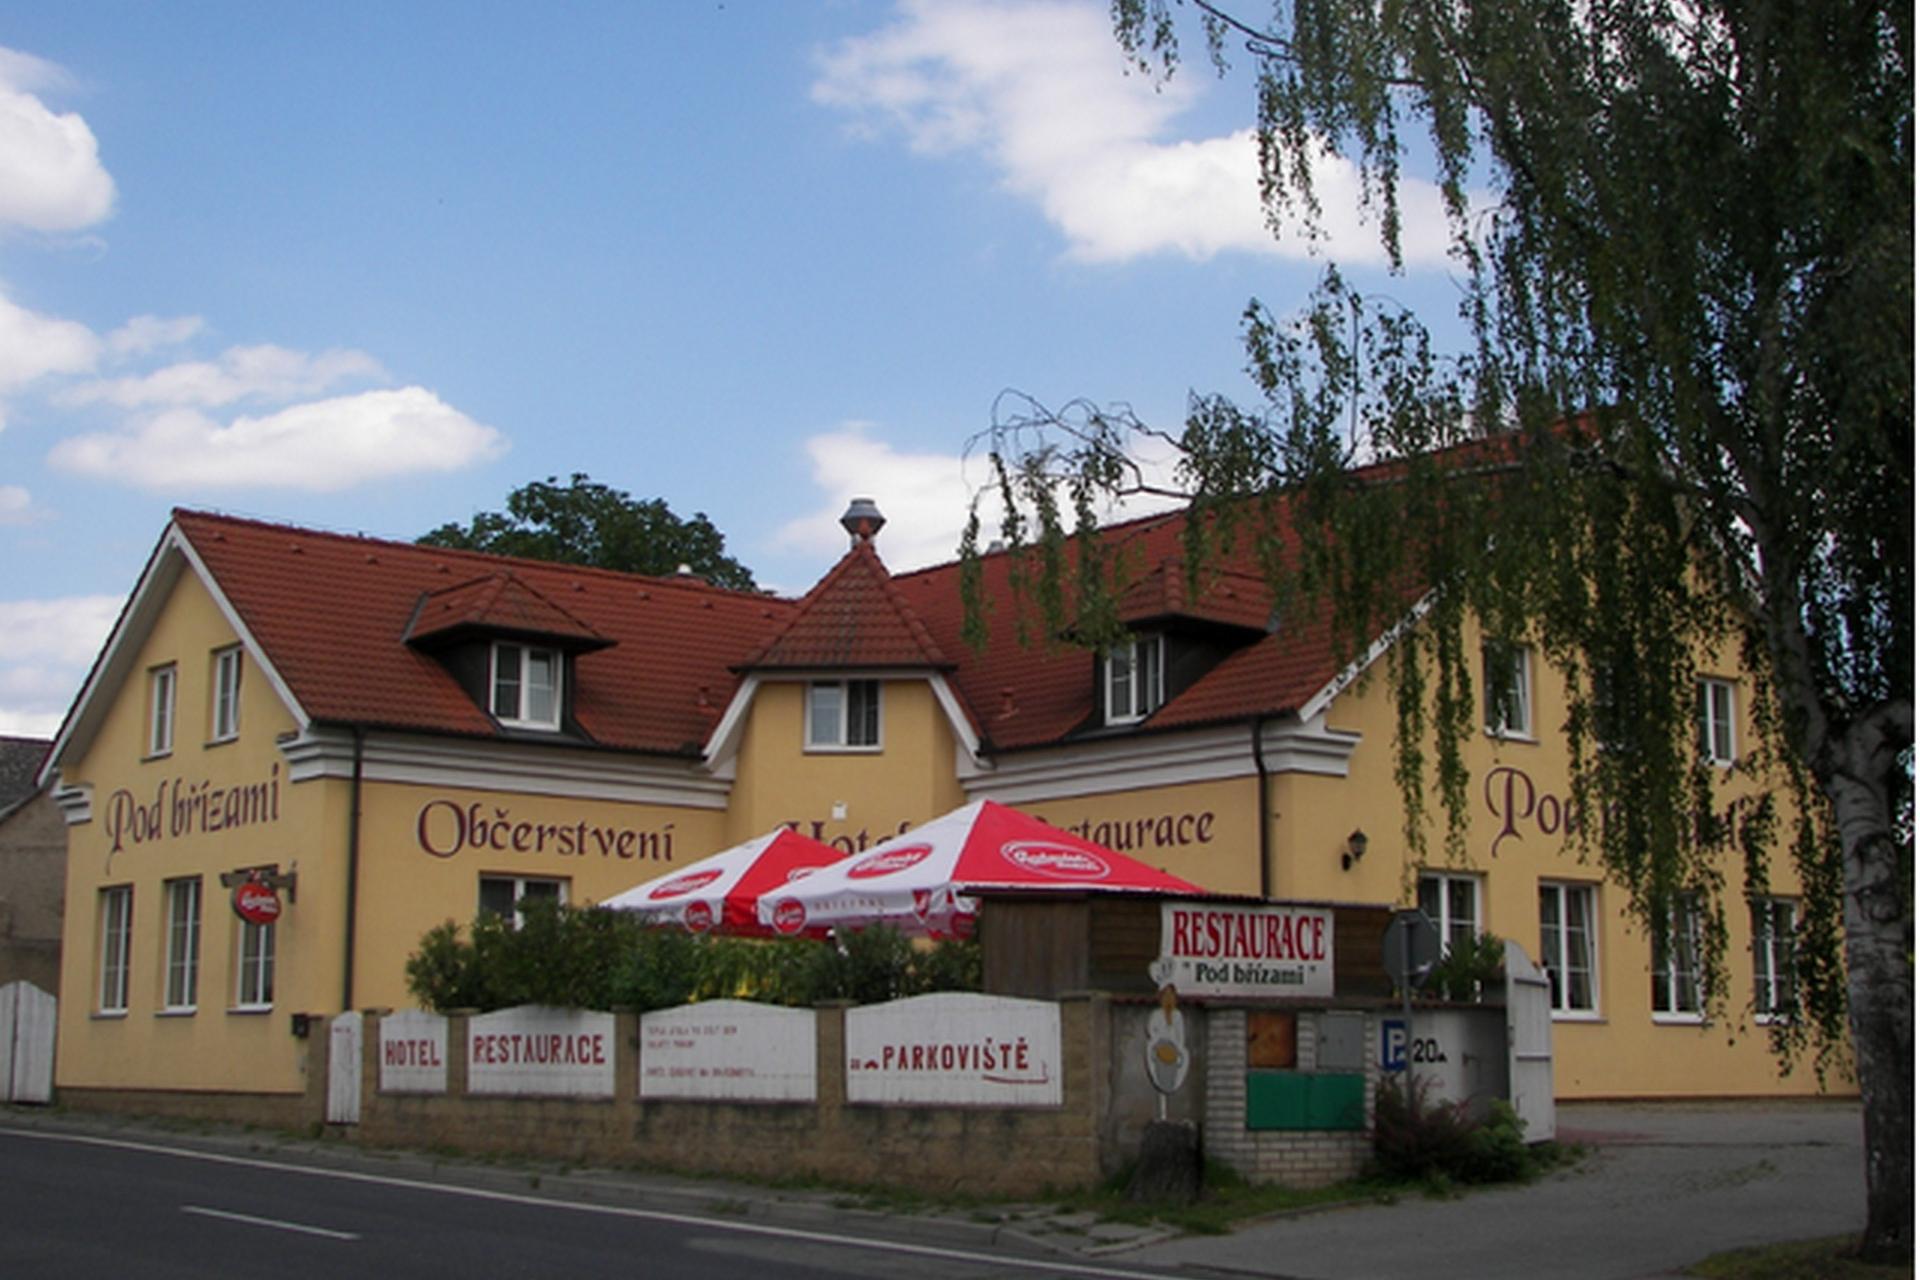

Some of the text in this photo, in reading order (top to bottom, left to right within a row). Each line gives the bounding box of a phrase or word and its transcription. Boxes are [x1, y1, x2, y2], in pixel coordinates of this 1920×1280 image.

[105, 762, 279, 877] Pod břízami
[417, 800, 676, 862] Občerstvení
[1034, 810, 1215, 851] taurace
[1172, 911, 1326, 961] RESTAURACE
[1195, 963, 1229, 984] Pod
[384, 1039, 441, 1067] HOTEL
[473, 1034, 606, 1065] RESTAURACE
[882, 1036, 1030, 1071] PARKOVIŠTĚ
[1412, 1037, 1438, 1063] 20
